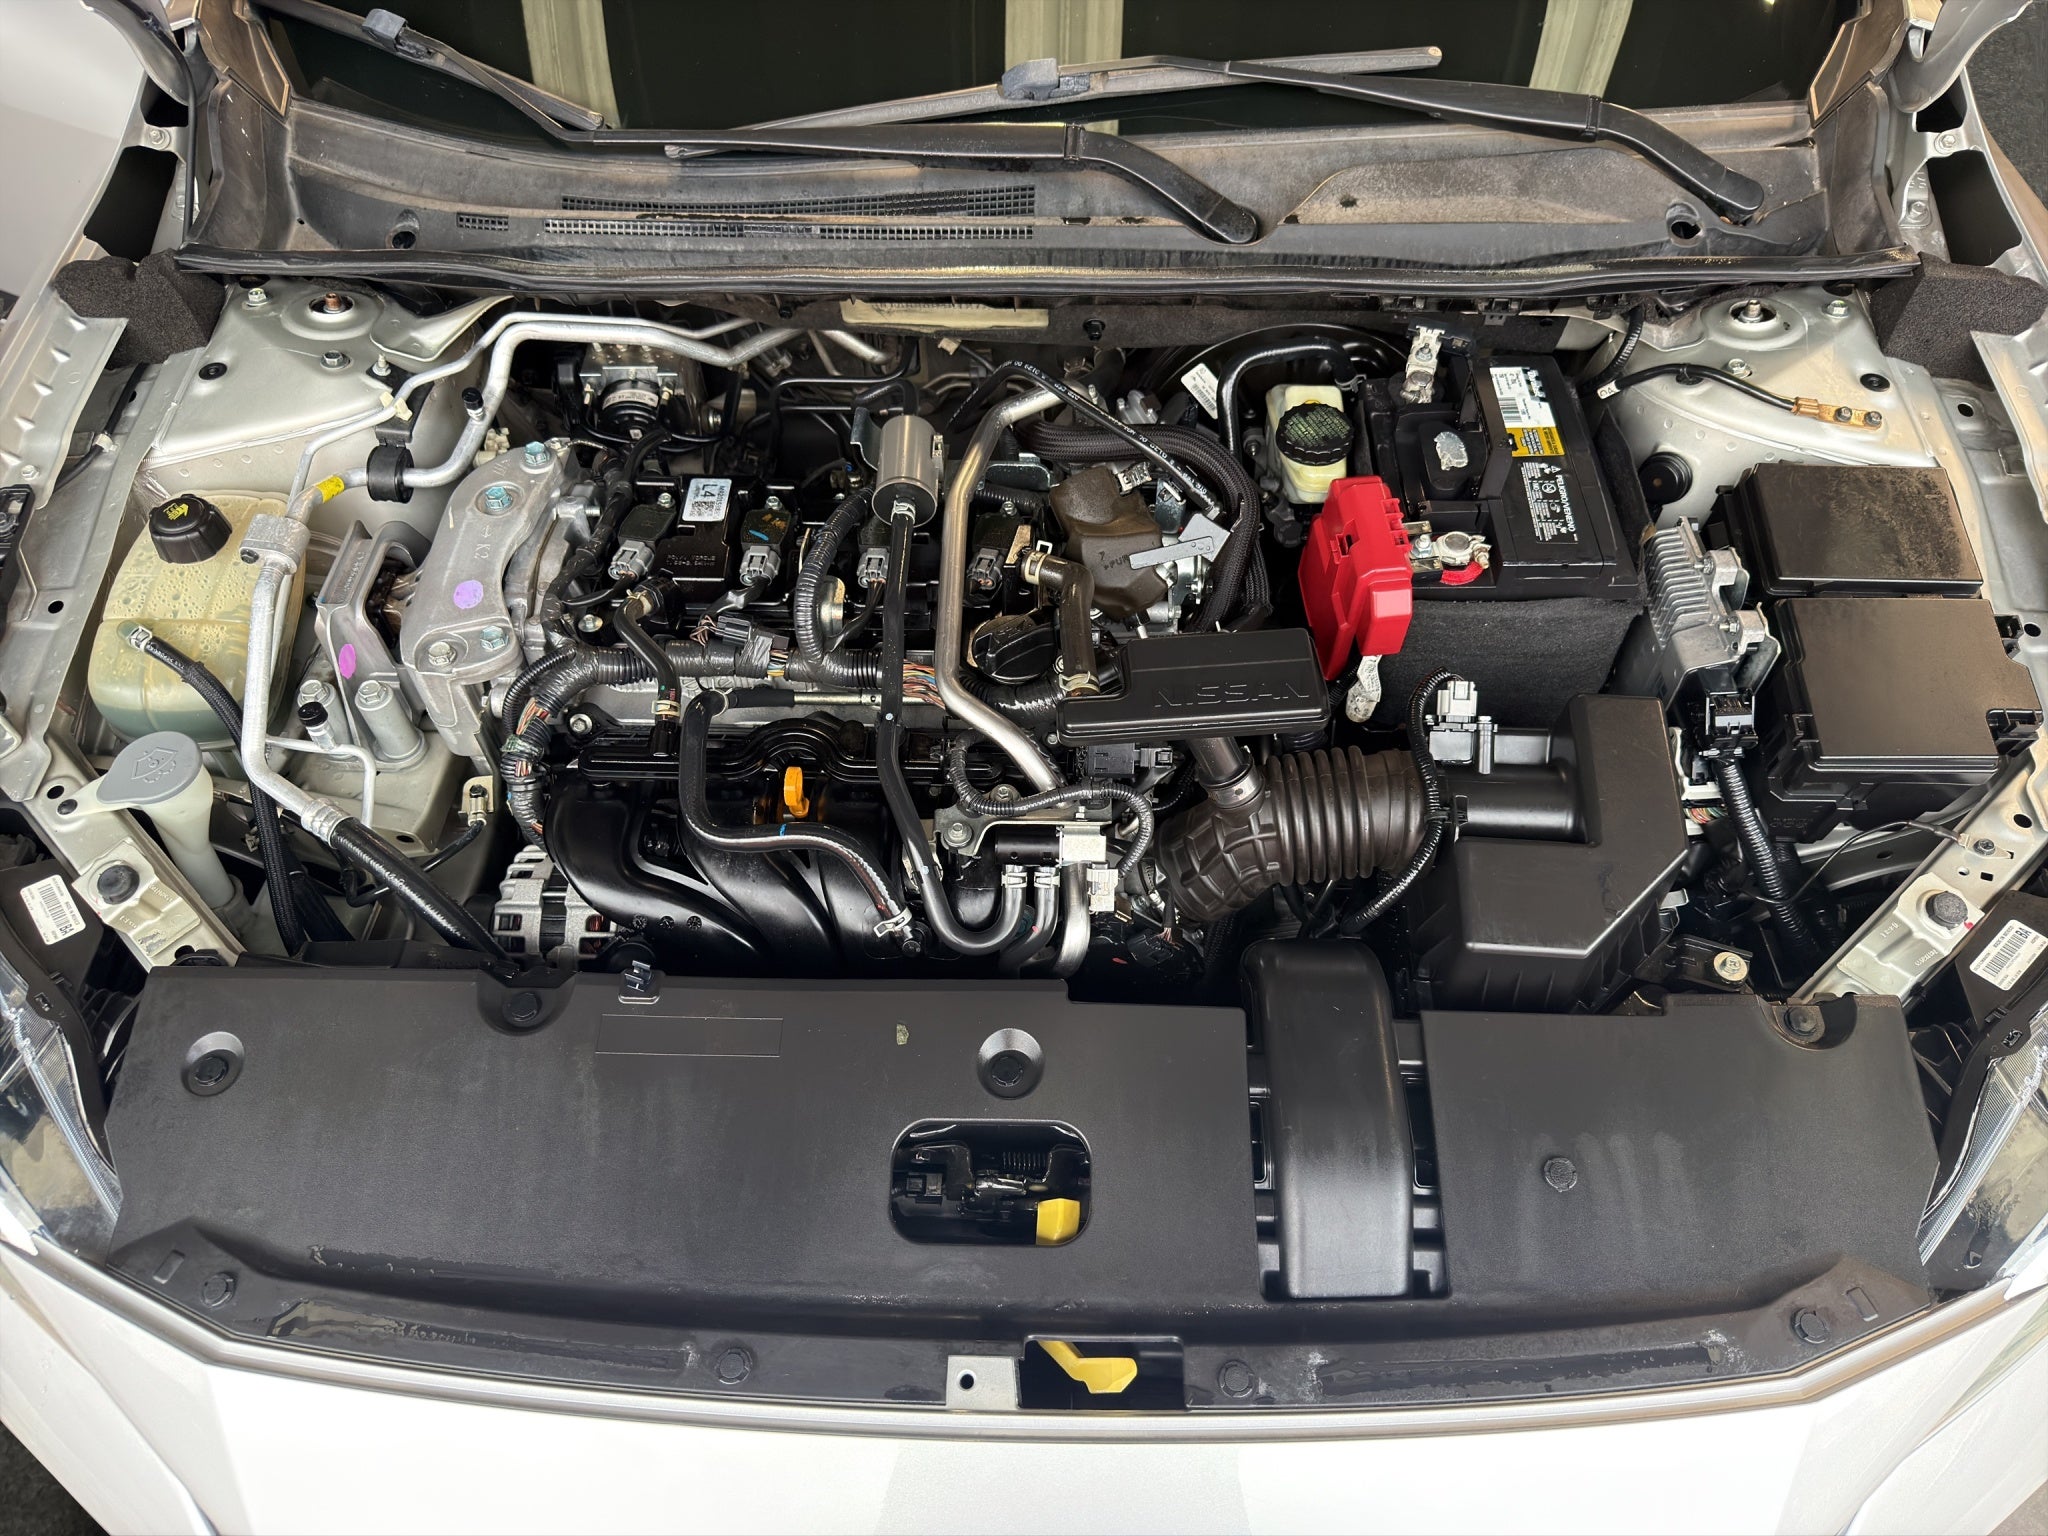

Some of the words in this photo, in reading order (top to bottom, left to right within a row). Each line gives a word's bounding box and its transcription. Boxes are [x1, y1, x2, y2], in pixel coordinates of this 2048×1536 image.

[701, 484, 718, 498] L4
[1154, 682, 1310, 708] NISSAN
[2015, 924, 2033, 942] BA
